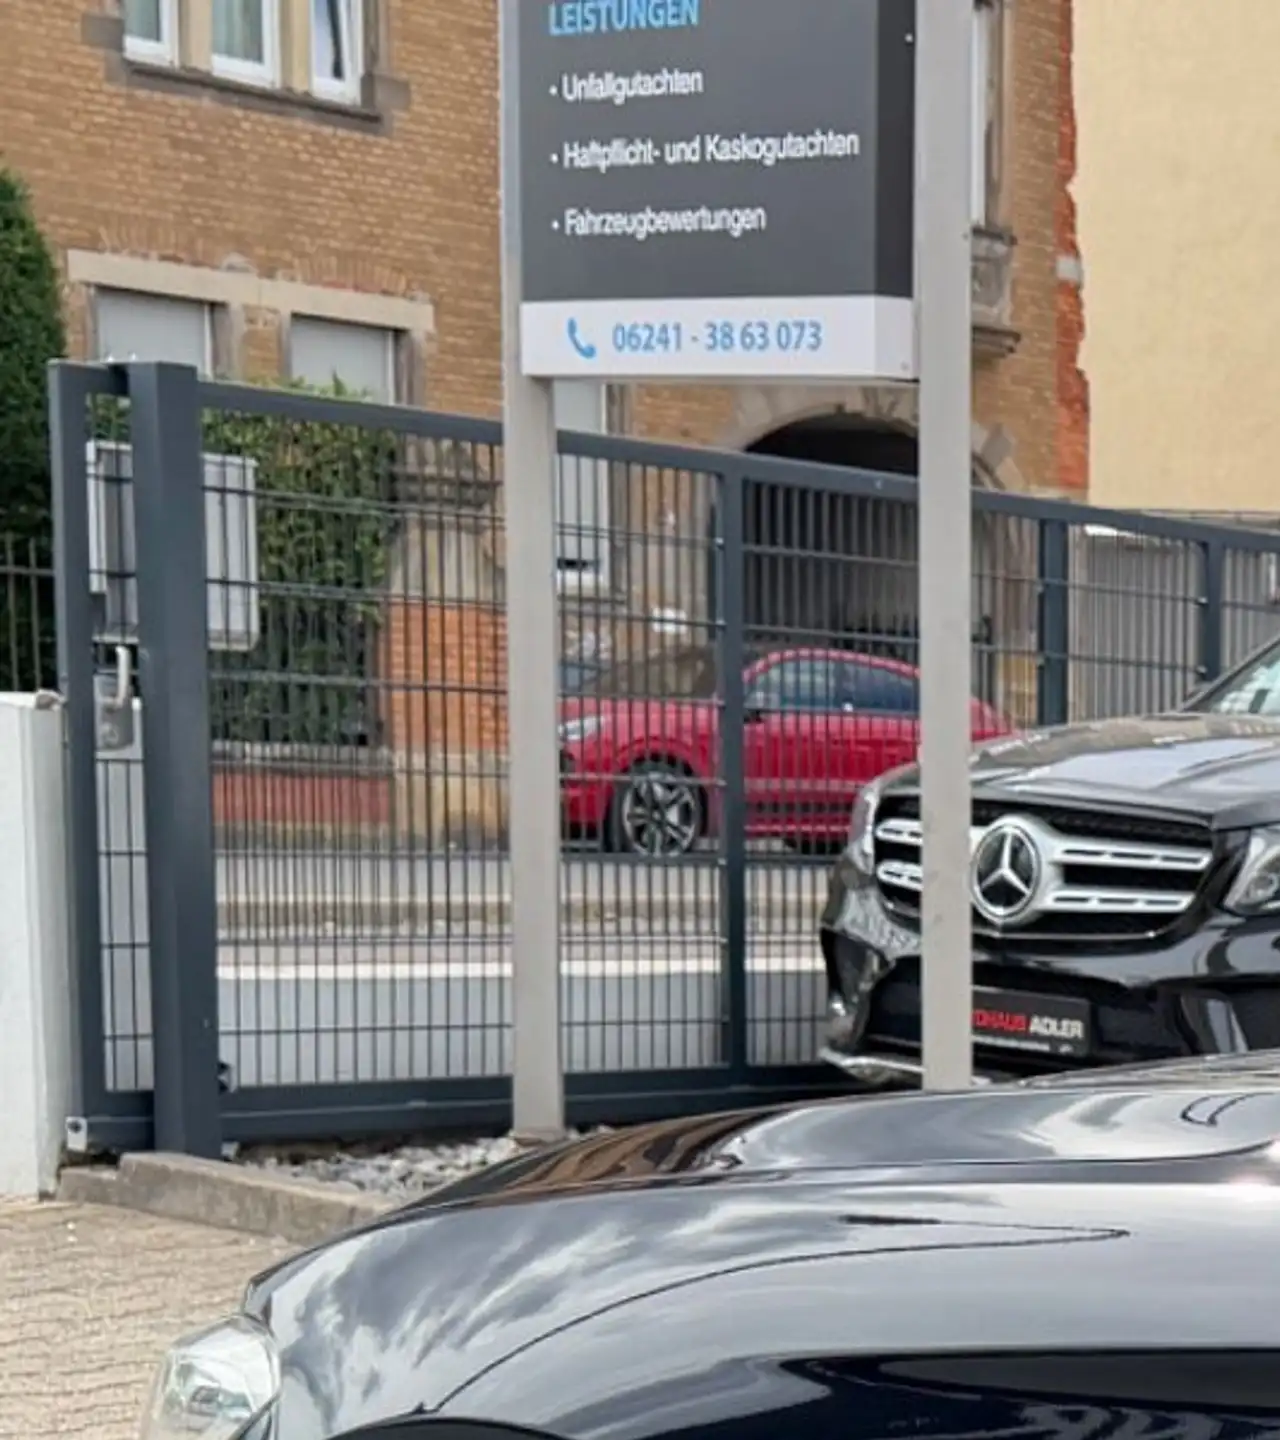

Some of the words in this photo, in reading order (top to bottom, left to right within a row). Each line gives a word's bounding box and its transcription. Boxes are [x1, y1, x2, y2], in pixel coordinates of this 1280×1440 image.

[548, 0, 699, 35] LEISTUNGEN
[561, 67, 704, 105] Unfallgutachten
[564, 138, 660, 173] Haftpflicht-
[664, 135, 700, 164] und
[705, 129, 860, 166] Kaskogutachten
[564, 205, 767, 241] Fahrzeugbewertungen
[612, 322, 682, 351] 06241
[704, 321, 734, 351] 38
[740, 320, 770, 350] 63
[776, 320, 822, 350] 073
